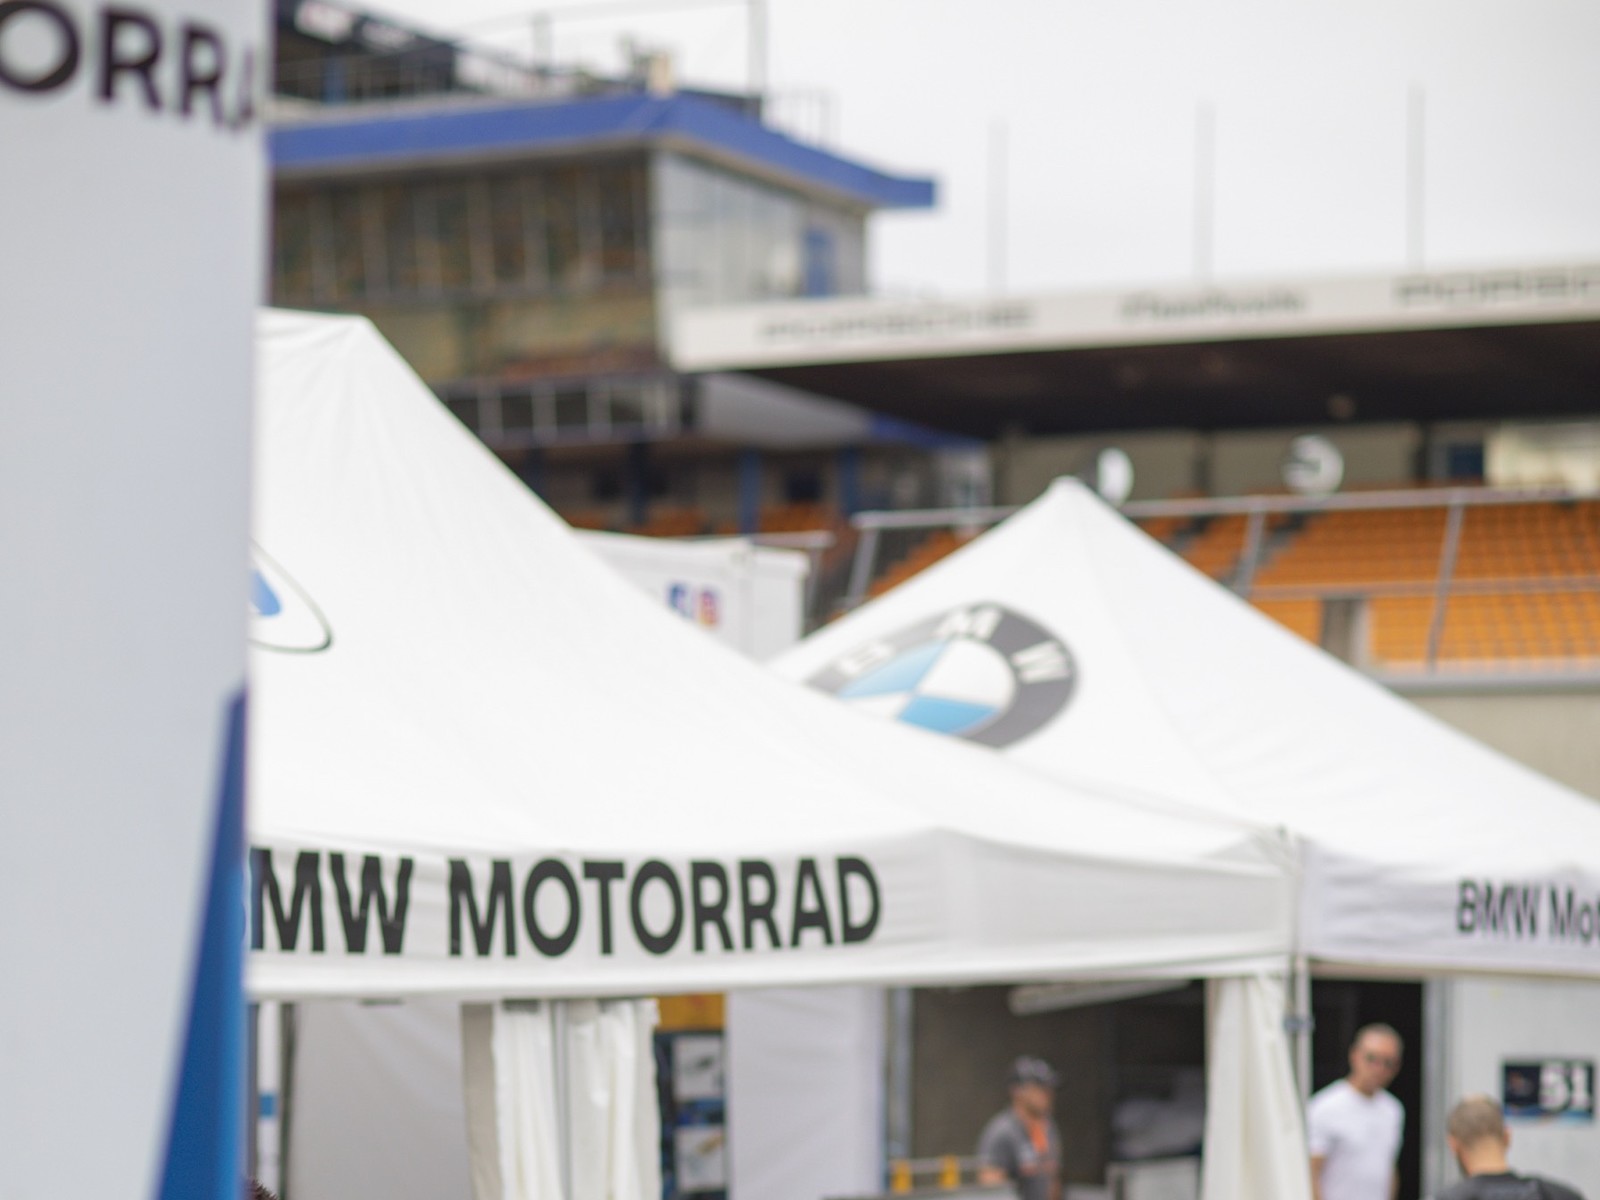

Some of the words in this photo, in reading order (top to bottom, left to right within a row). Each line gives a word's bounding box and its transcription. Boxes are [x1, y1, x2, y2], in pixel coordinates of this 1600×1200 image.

[0, 0, 256, 134] ORR
[448, 856, 883, 958] MOTORRAD
[1456, 878, 1542, 938] BMW
